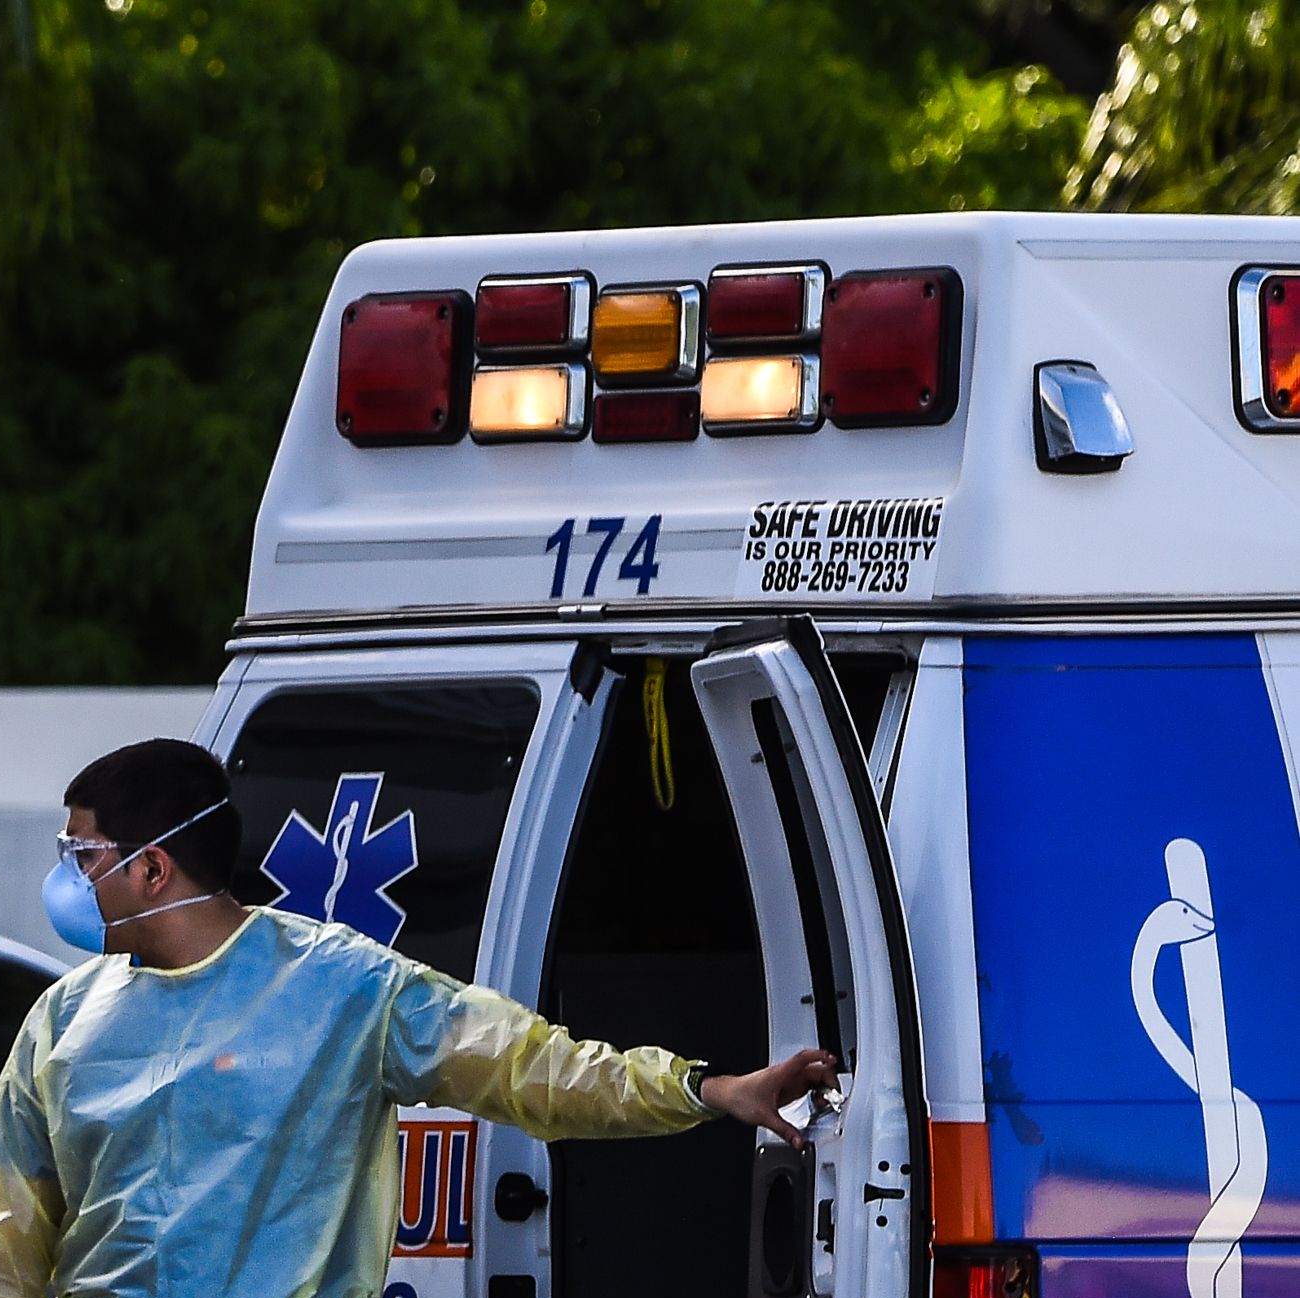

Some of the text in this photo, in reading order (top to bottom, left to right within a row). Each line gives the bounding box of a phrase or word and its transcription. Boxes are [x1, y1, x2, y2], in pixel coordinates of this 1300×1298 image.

[750, 497, 944, 539] SAFE DRIVING
[545, 513, 662, 599] 174
[745, 541, 936, 560] IS OUR PRIORITY
[761, 560, 910, 593] 888-269-7233
